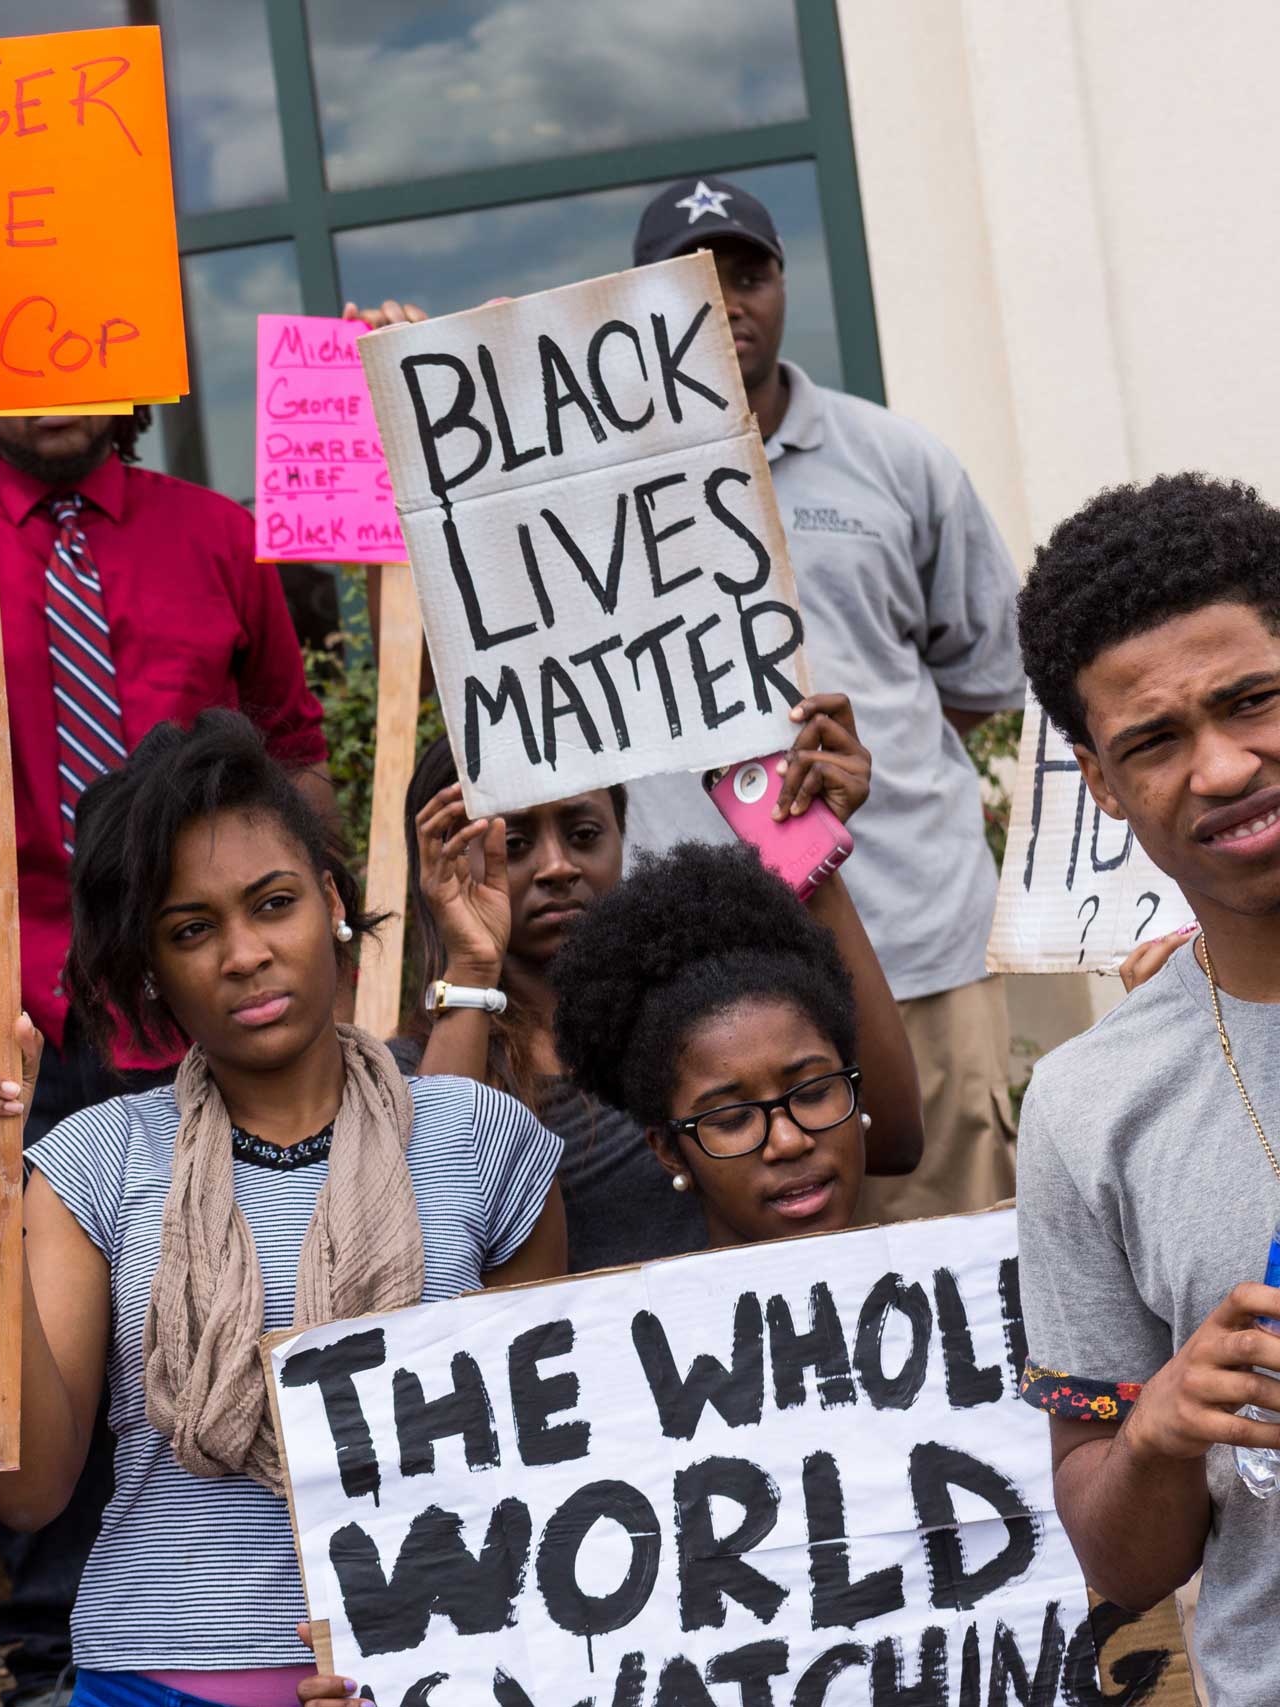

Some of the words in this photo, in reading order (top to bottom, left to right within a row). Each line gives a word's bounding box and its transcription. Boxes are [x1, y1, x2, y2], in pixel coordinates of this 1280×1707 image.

[401, 302, 729, 498] BLACK
[442, 468, 771, 650] LIVES
[464, 601, 804, 783] MATTER
[280, 1319, 591, 1503] THE
[329, 1441, 1042, 1660] WORLD
